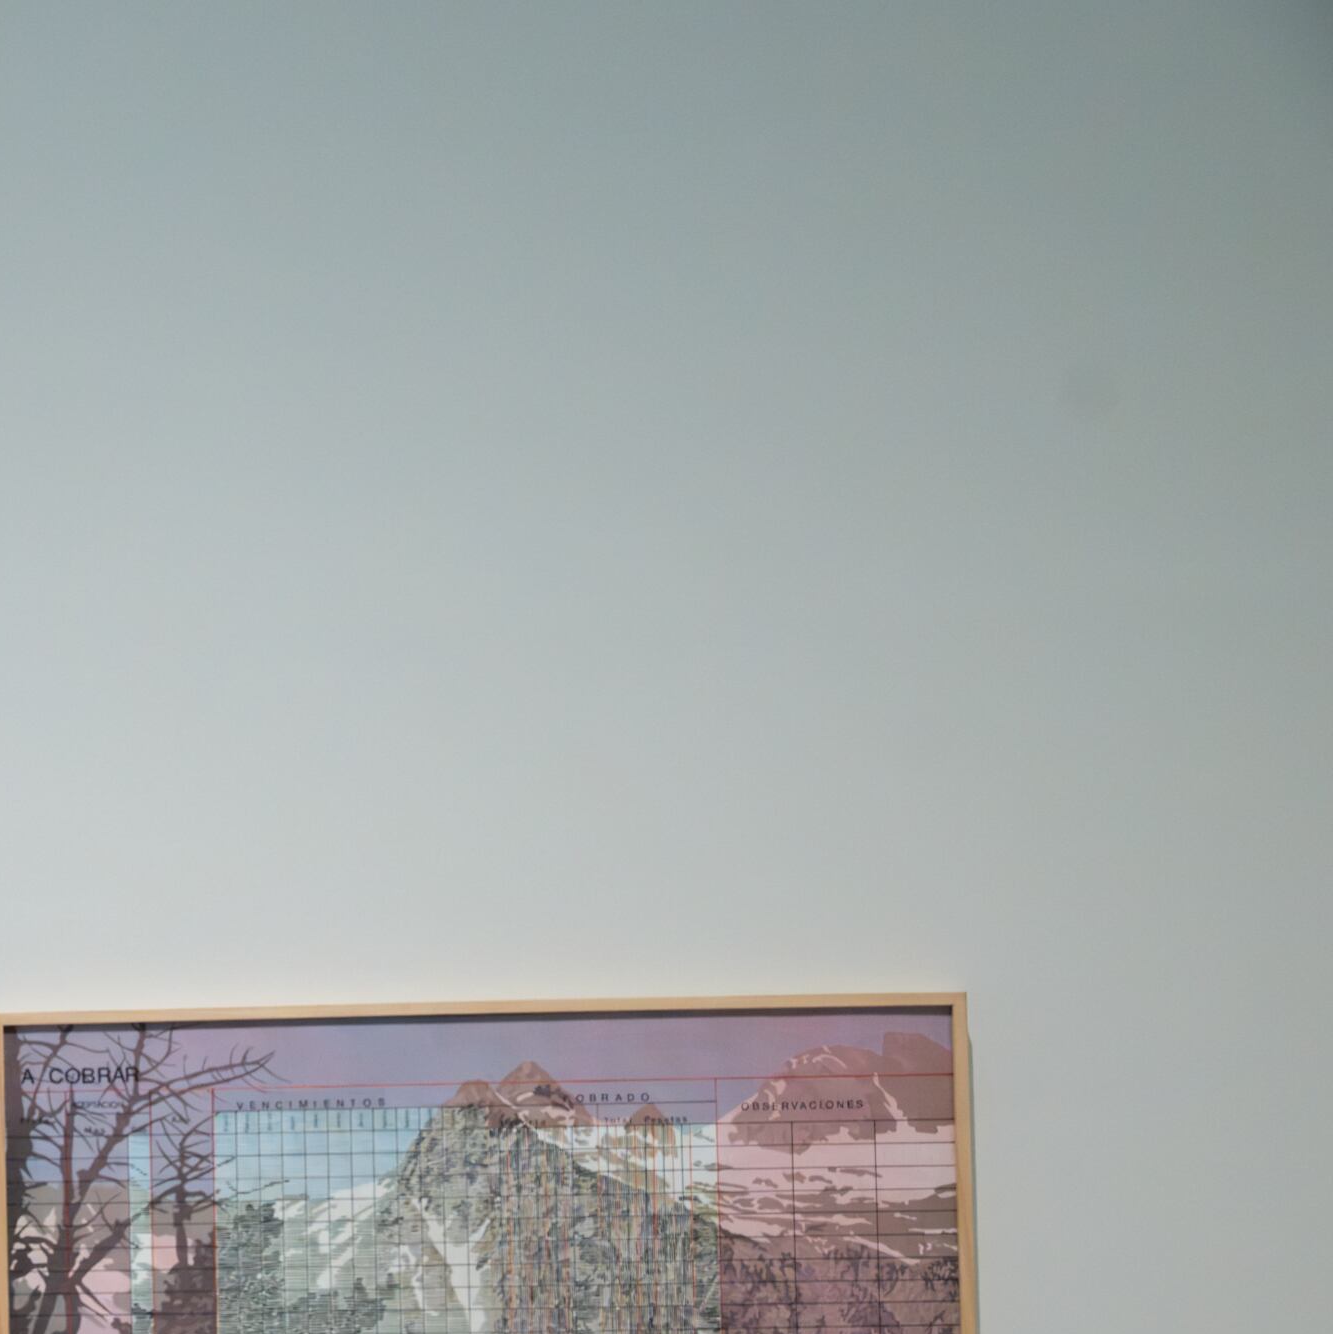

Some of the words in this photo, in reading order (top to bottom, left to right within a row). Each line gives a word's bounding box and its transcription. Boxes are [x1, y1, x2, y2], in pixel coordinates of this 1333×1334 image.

[21, 1068, 35, 1085] A
[48, 1066, 140, 1085] COBRAR
[235, 1097, 386, 1111] VENCIMIENTOS
[563, 1092, 651, 1104] OBRADO
[740, 1098, 865, 1112] OBSERVACIONES
